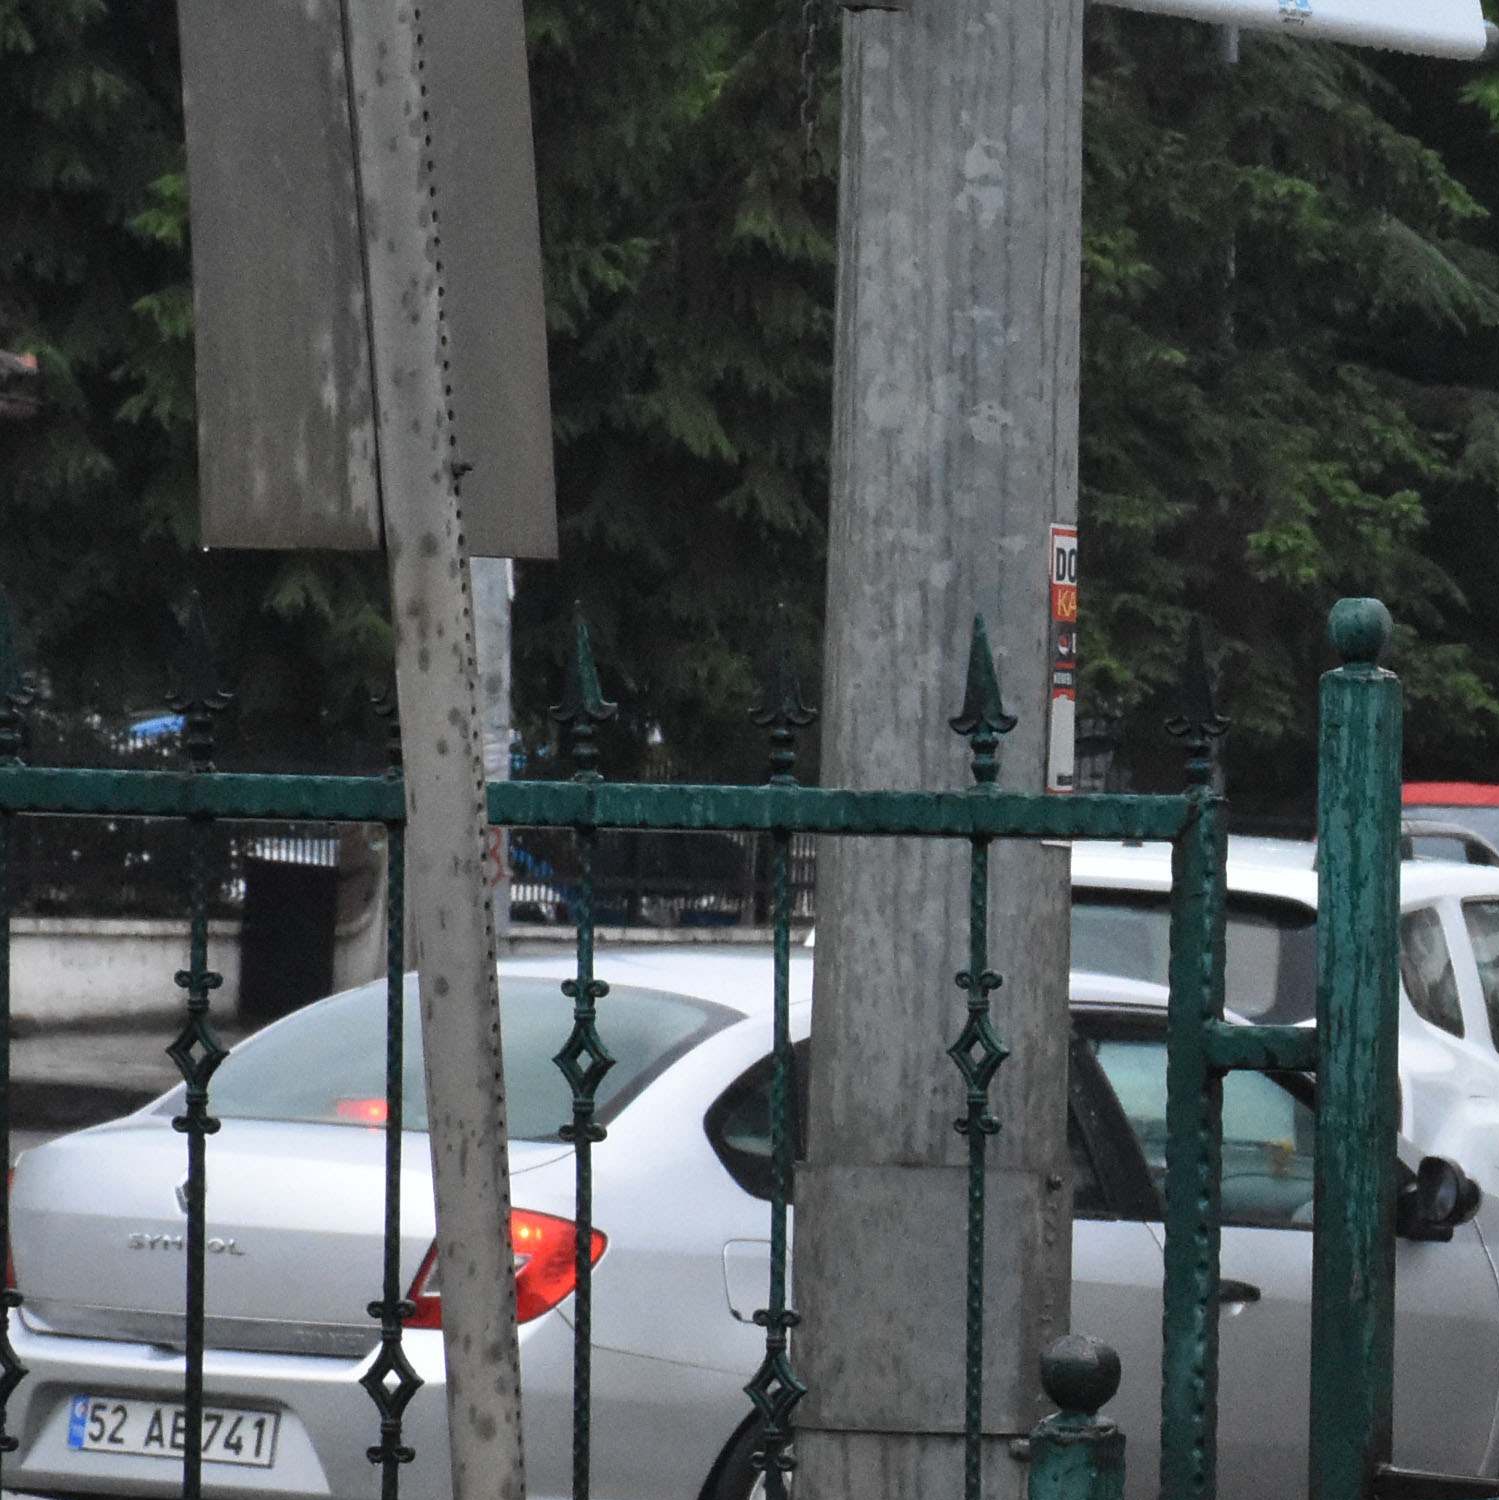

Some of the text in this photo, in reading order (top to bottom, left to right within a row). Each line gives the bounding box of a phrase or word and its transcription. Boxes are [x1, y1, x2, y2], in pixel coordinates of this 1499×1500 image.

[128, 1232, 246, 1256] SYMOL
[87, 1402, 128, 1445] 52
[201, 1411, 268, 1458] 741
